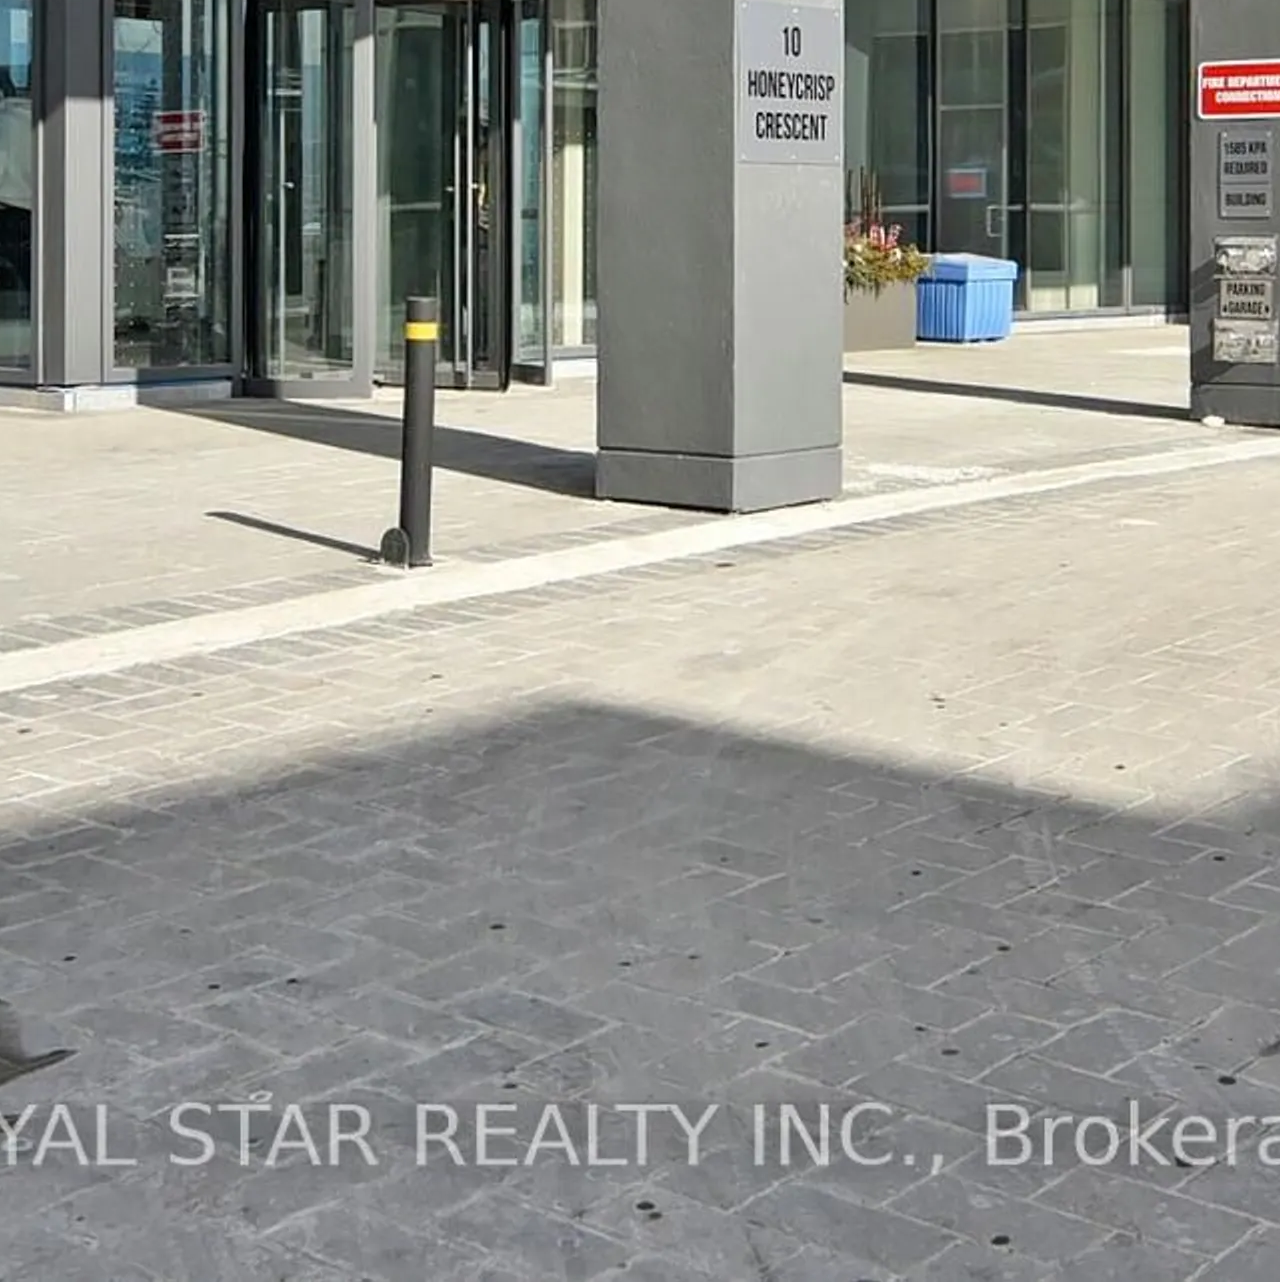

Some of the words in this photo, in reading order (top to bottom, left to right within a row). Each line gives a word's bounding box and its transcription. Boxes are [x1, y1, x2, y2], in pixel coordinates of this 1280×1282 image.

[782, 26, 802, 57] 10
[748, 70, 835, 101] HONEYCRISP
[1203, 77, 1225, 89] FIRE
[755, 112, 828, 141] CRESCENT
[1224, 161, 1267, 175] REQUIRED
[1225, 192, 1266, 206] BUILDING
[1226, 282, 1265, 295] PARKING
[1228, 301, 1263, 315] GARAGE
